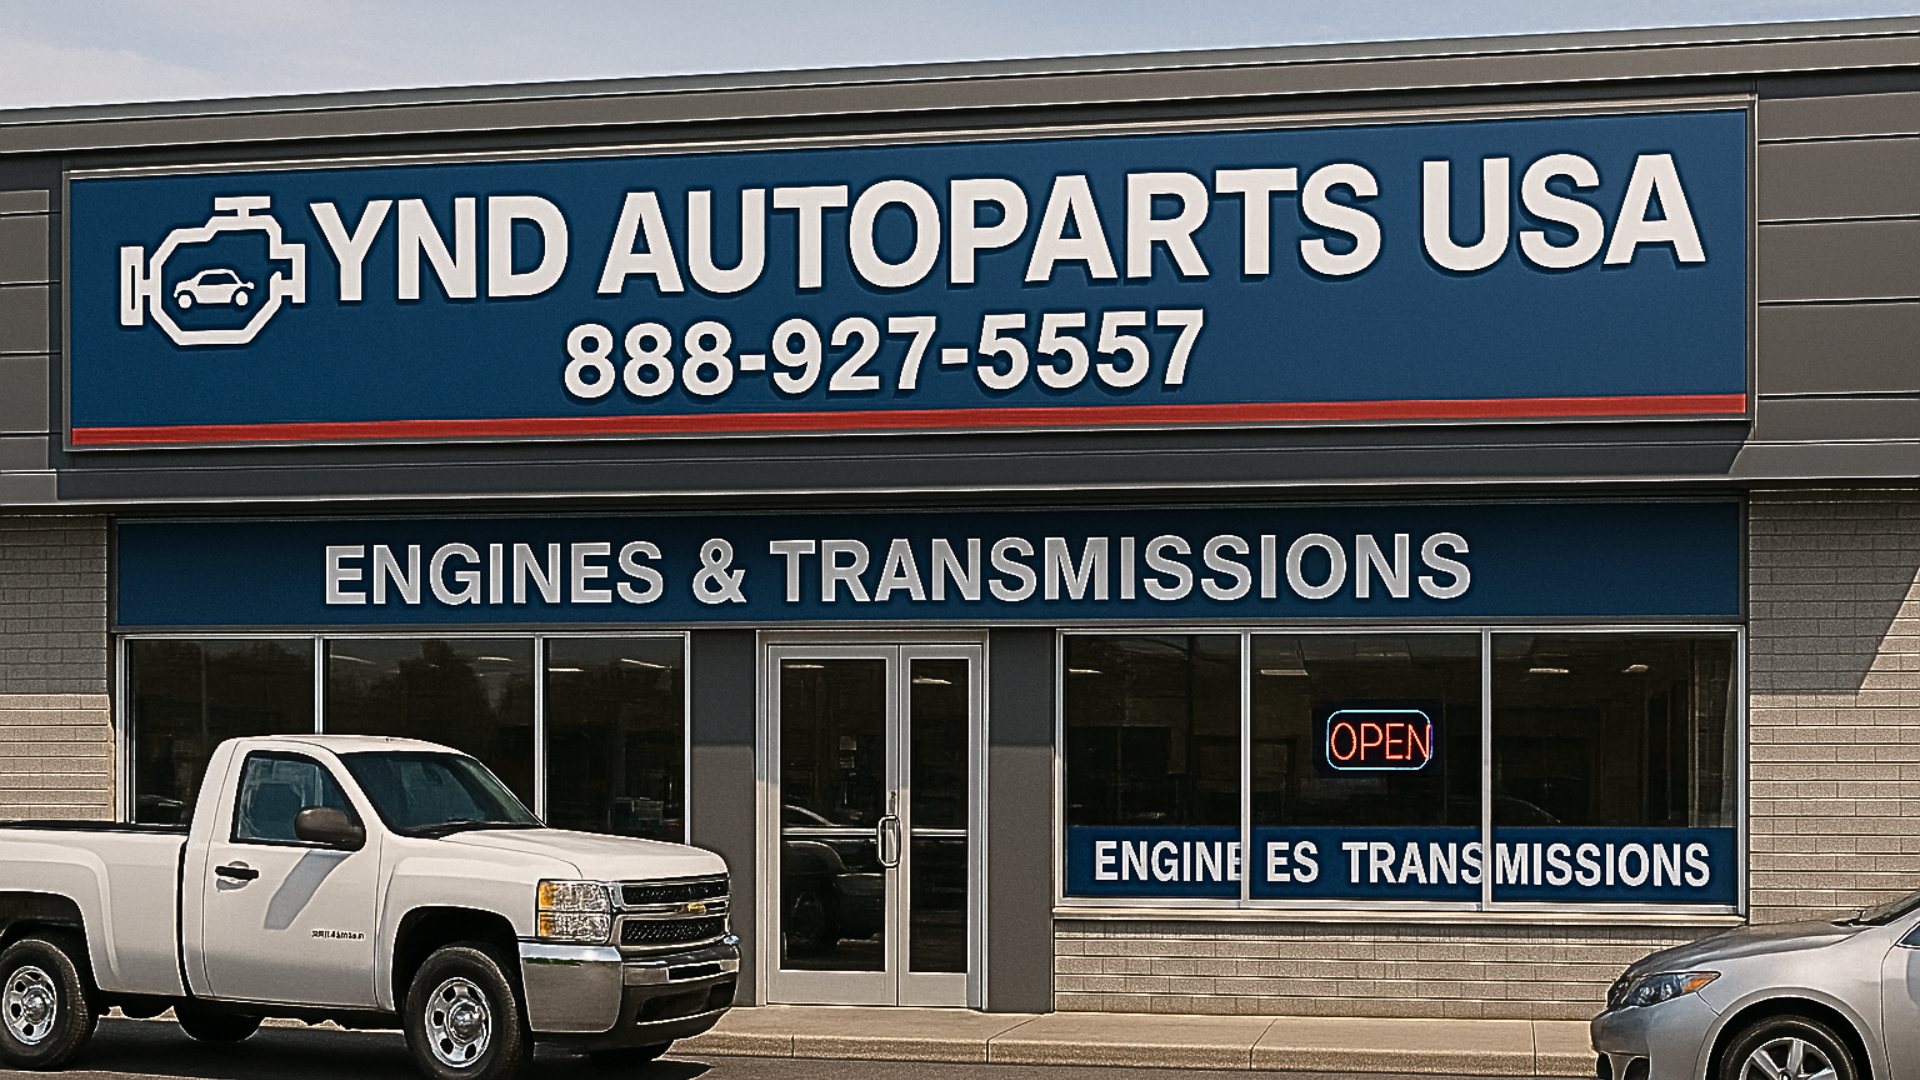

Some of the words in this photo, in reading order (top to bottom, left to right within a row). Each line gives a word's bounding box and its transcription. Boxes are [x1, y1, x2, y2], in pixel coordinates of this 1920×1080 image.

[310, 195, 569, 301] YND
[597, 163, 1381, 294] AUTOPARTS
[1423, 153, 1706, 271] USA
[564, 308, 1204, 399] 888-927-5557
[325, 540, 664, 606] ENGINES
[692, 538, 747, 605] &
[769, 532, 1471, 602] TRANSMISSIONS
[1330, 722, 1431, 761] OPEN
[1267, 840, 1319, 883] ES
